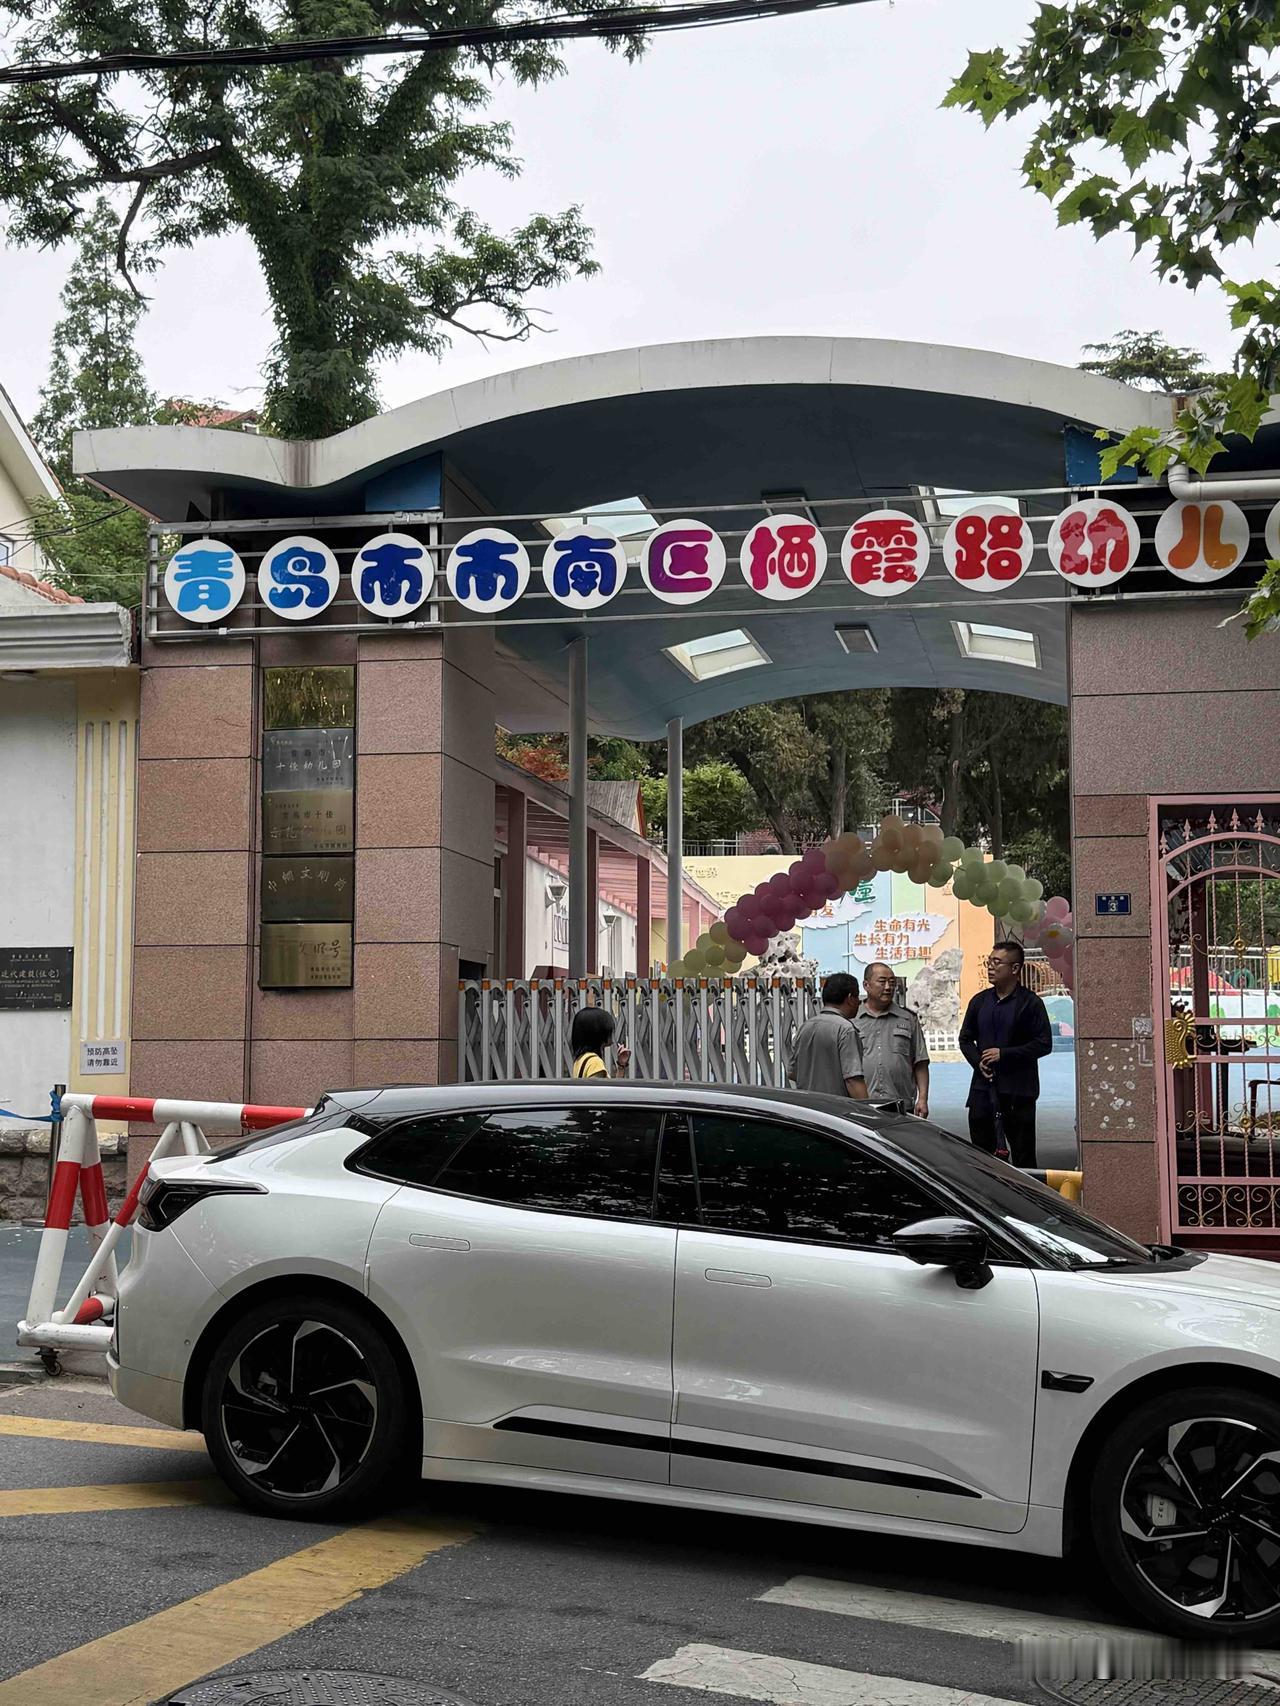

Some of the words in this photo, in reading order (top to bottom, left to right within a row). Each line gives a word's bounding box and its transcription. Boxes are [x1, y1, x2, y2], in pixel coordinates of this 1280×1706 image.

[173, 503, 1280, 612] 青岛市市南区栖霞路幼儿
[874, 919, 930, 932] 生命有光
[854, 933, 910, 946] 生长有力
[876, 947, 932, 960] 生活有趣
